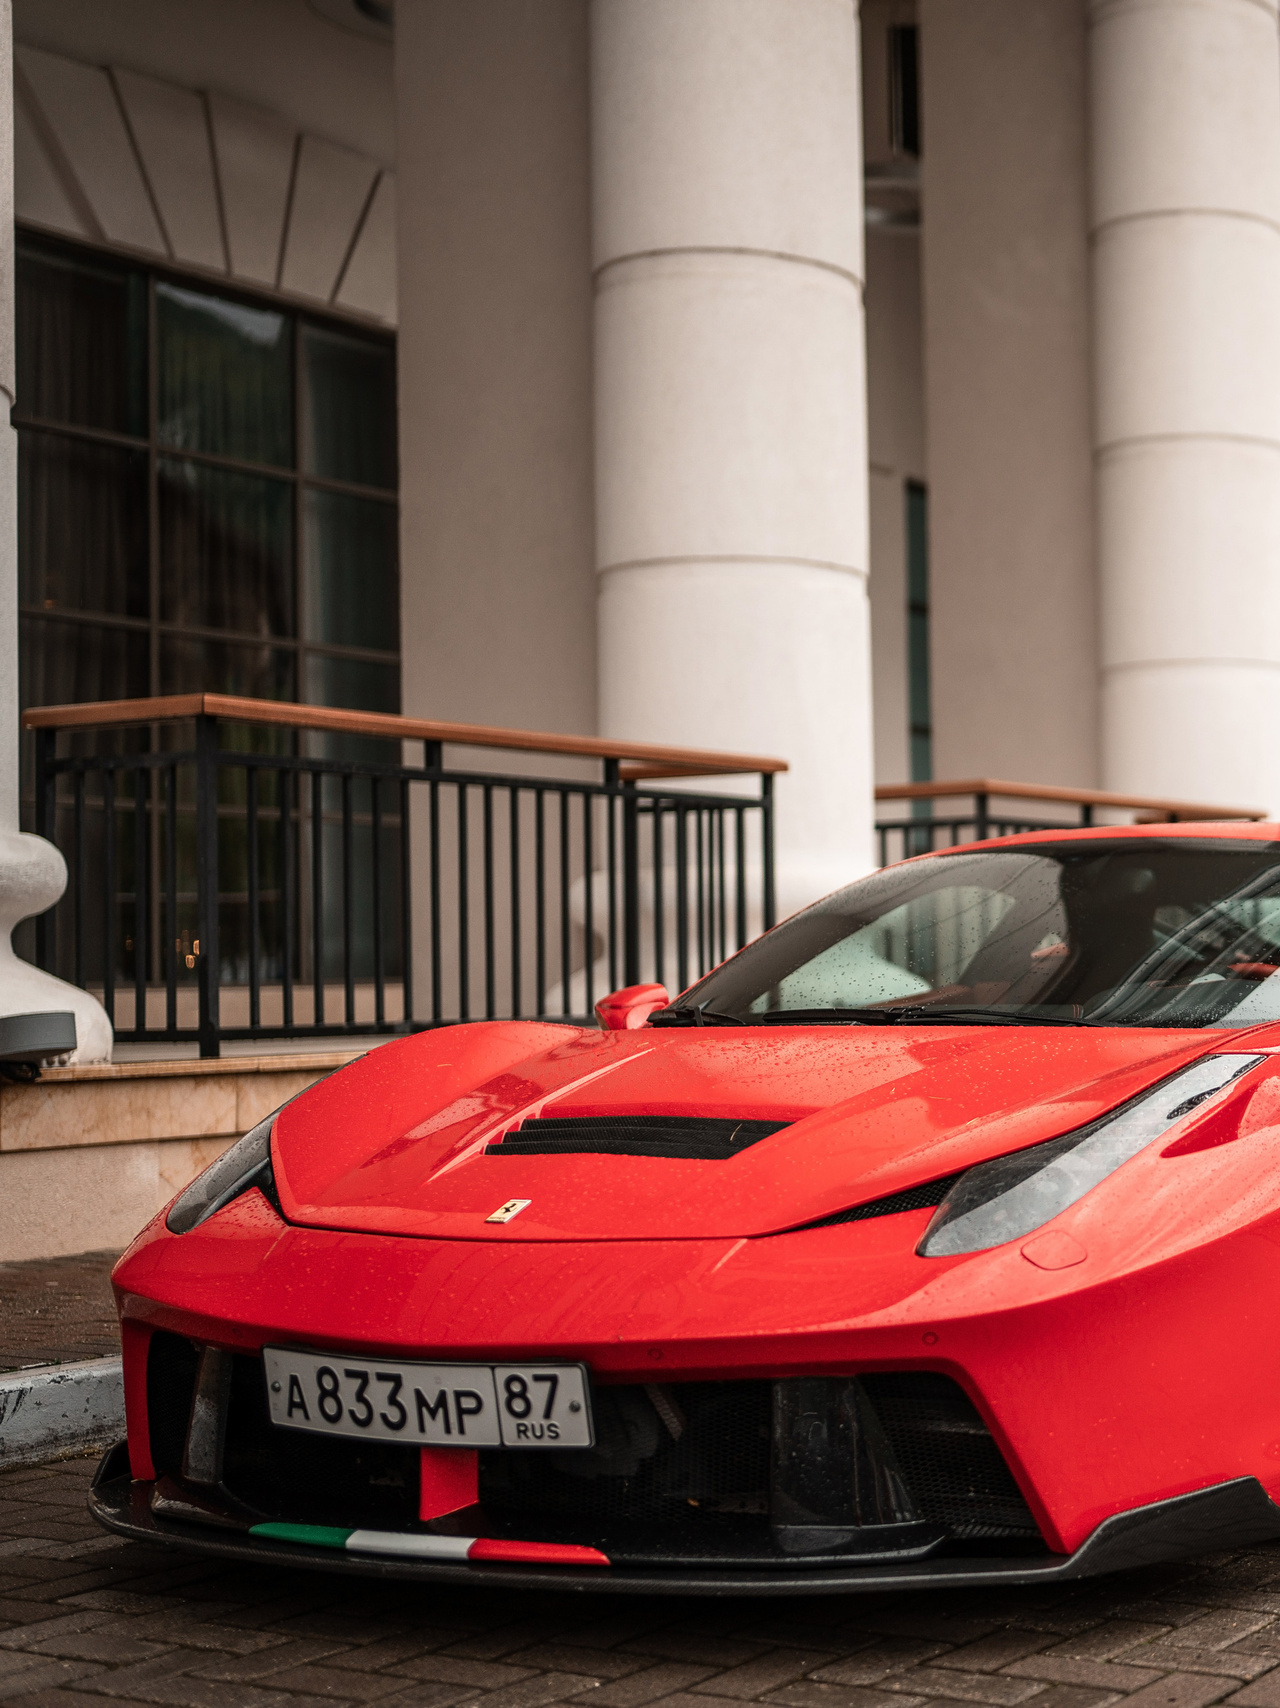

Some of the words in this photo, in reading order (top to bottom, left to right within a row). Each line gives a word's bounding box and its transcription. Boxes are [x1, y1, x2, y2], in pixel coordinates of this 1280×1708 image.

[287, 1365, 484, 1436] A833MP
[503, 1373, 560, 1420] 87
[516, 1422, 561, 1440] RUS
